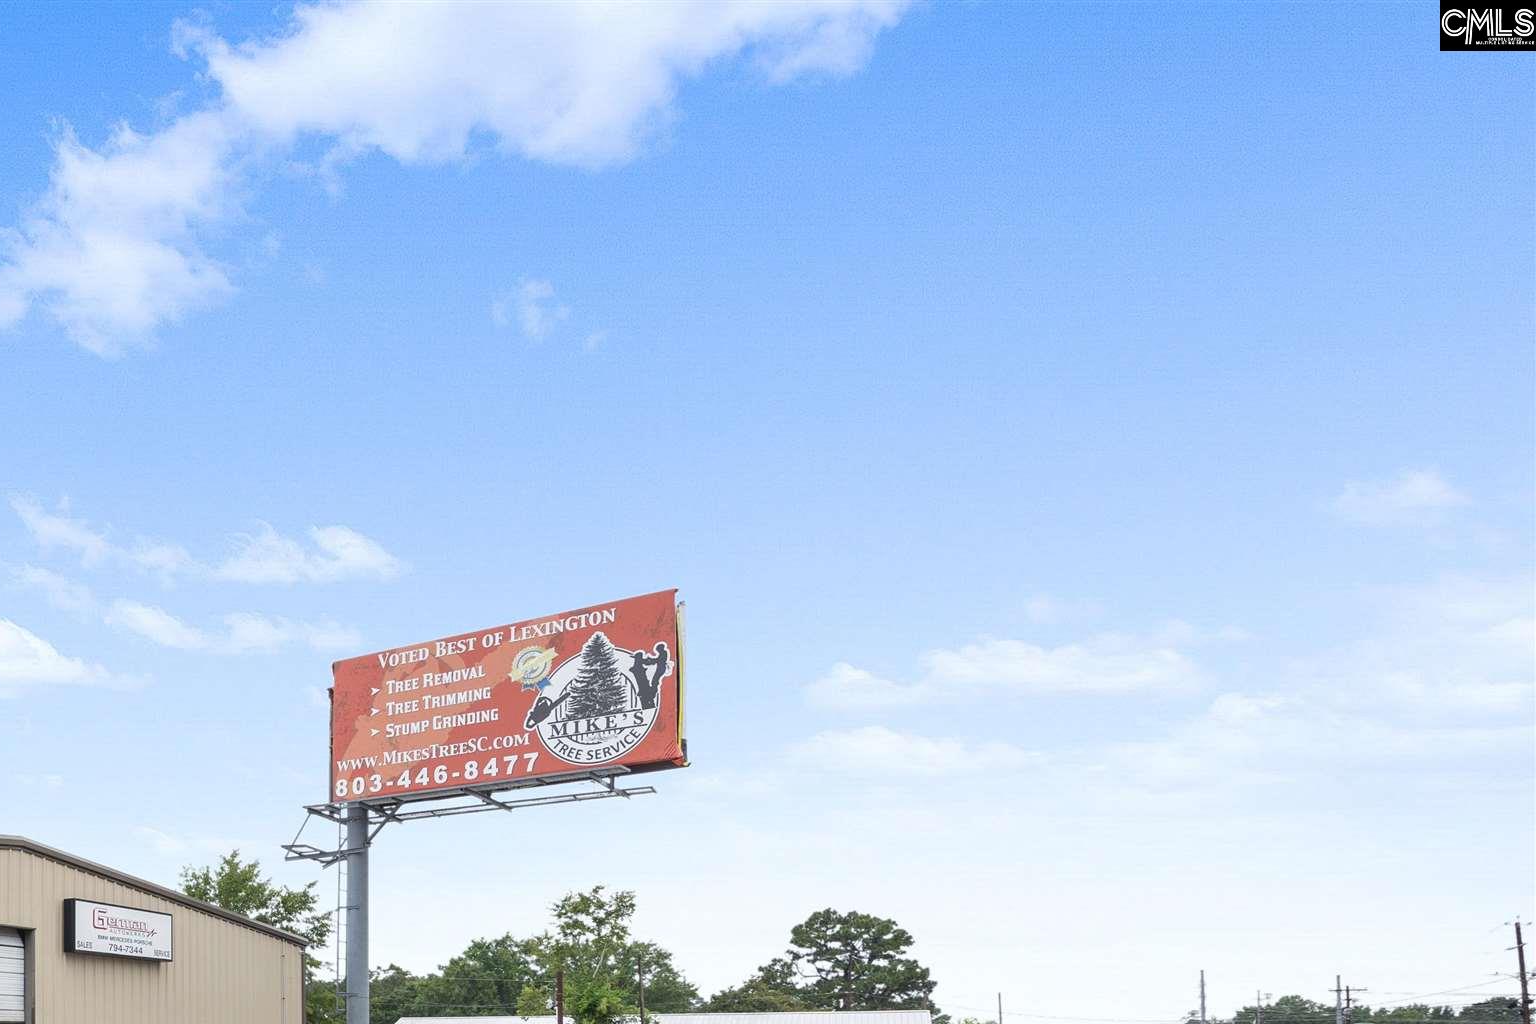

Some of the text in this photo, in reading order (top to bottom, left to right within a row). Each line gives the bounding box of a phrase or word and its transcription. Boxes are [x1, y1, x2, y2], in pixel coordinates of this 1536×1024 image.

[377, 647, 429, 669] VOTED
[435, 637, 476, 659] BEST
[510, 608, 616, 643] LEXINGTON
[386, 665, 486, 695] TREE REMOVAL
[385, 686, 491, 716] TREE TRIMMING
[385, 708, 499, 738] STUMP GRINDING
[551, 711, 644, 737] MIKE'S
[553, 728, 641, 760] TREE SERVICE
[335, 752, 539, 797] 803-446-8477
[109, 943, 143, 954] 794-7344
